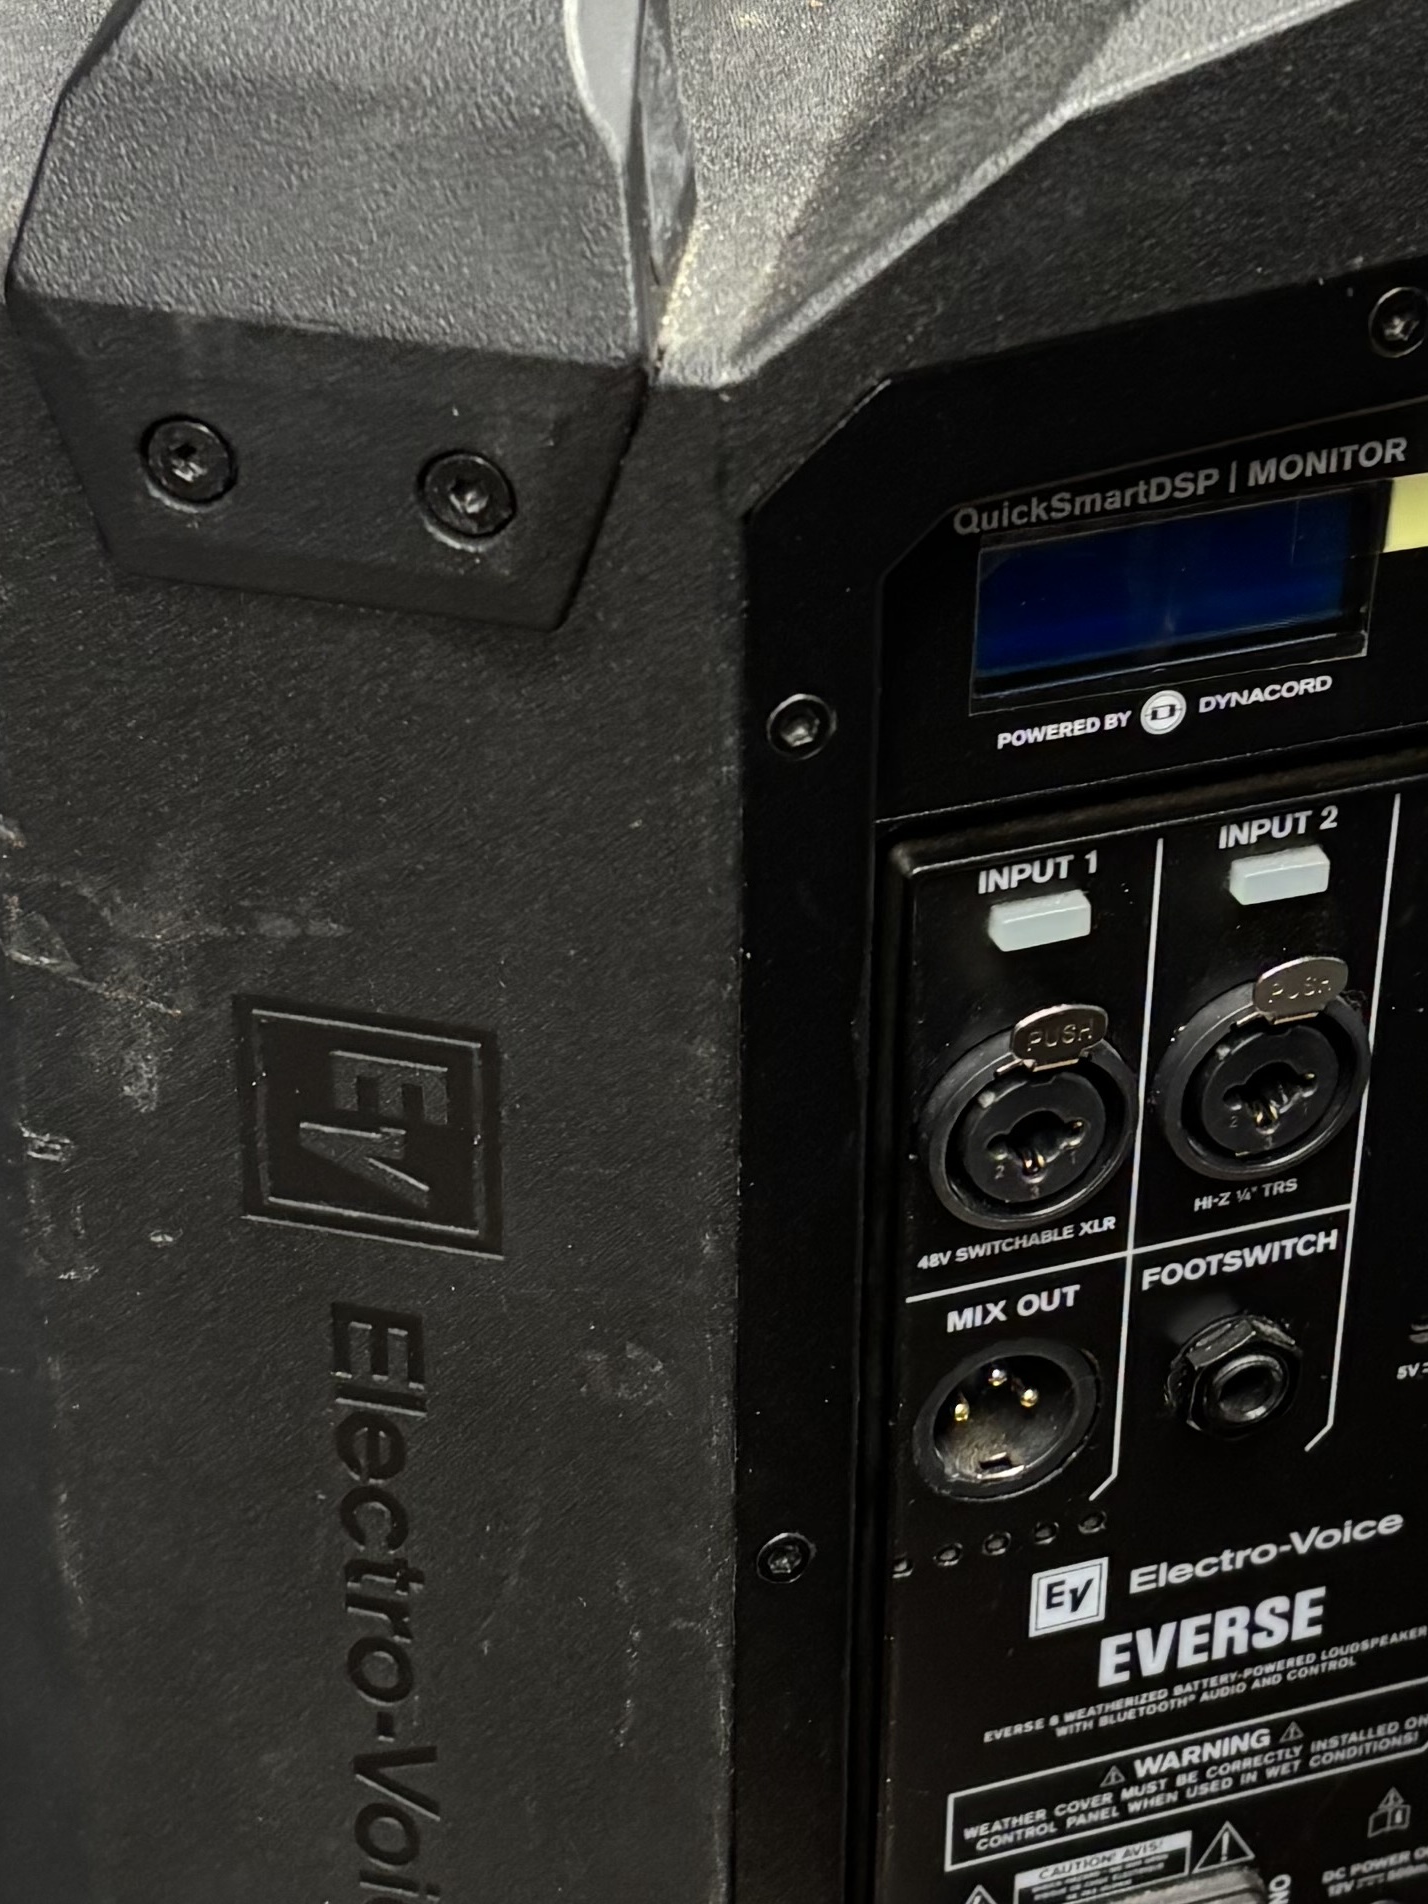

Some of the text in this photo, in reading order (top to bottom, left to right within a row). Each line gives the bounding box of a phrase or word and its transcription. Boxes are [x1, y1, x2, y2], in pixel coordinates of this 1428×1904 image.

[953, 467, 1220, 536] QuickSmartDSP
[1247, 437, 1408, 488] MONITOR
[996, 675, 1333, 750] POWERED BY DYNACORD
[1217, 805, 1339, 850] INPUT 2
[978, 849, 1100, 896] INPUT 1
[1268, 975, 1332, 1003] PUSH
[1027, 1019, 1094, 1052] PUSH
[1194, 1191, 1232, 1212] HI-Z
[1262, 1177, 1299, 1198] TRS
[916, 1215, 1117, 1271] 48V SWITCHABLE XLR
[1140, 1229, 1339, 1291] FOOTSWITCH
[946, 1284, 1081, 1334] MIX OUT
[1396, 1362, 1421, 1380] 5V
[1128, 1510, 1405, 1594] Electro-Voice
[1097, 1586, 1327, 1688] EVERSE
[983, 1717, 1045, 1744] EVERSE
[1063, 1688, 1168, 1723] WEATHERIZED
[1172, 1653, 1317, 1697] BATTERY-POWERED
[1320, 1625, 1428, 1661] LOUDSPEAKER
[1056, 1719, 1095, 1738] WITH
[1200, 1682, 1248, 1703] AUDIO
[1251, 1672, 1284, 1690] AND
[1287, 1656, 1358, 1682] CONTROL
[1134, 1727, 1272, 1778] WARNING
[963, 1806, 1048, 1841] WEATHER
[1054, 1791, 1113, 1818] COVER
[1120, 1778, 1168, 1801] MUST
[1176, 1770, 1200, 1788] BE
[1205, 1745, 1303, 1781] CORRECTLY
[1310, 1721, 1400, 1753] INSTALLED
[976, 1730, 1420, 1852] CONTROL PANEL WHEN USED IN WET CONDITIONS!
[1322, 1867, 1347, 1884] DC
[1350, 1850, 1411, 1877] POWER
